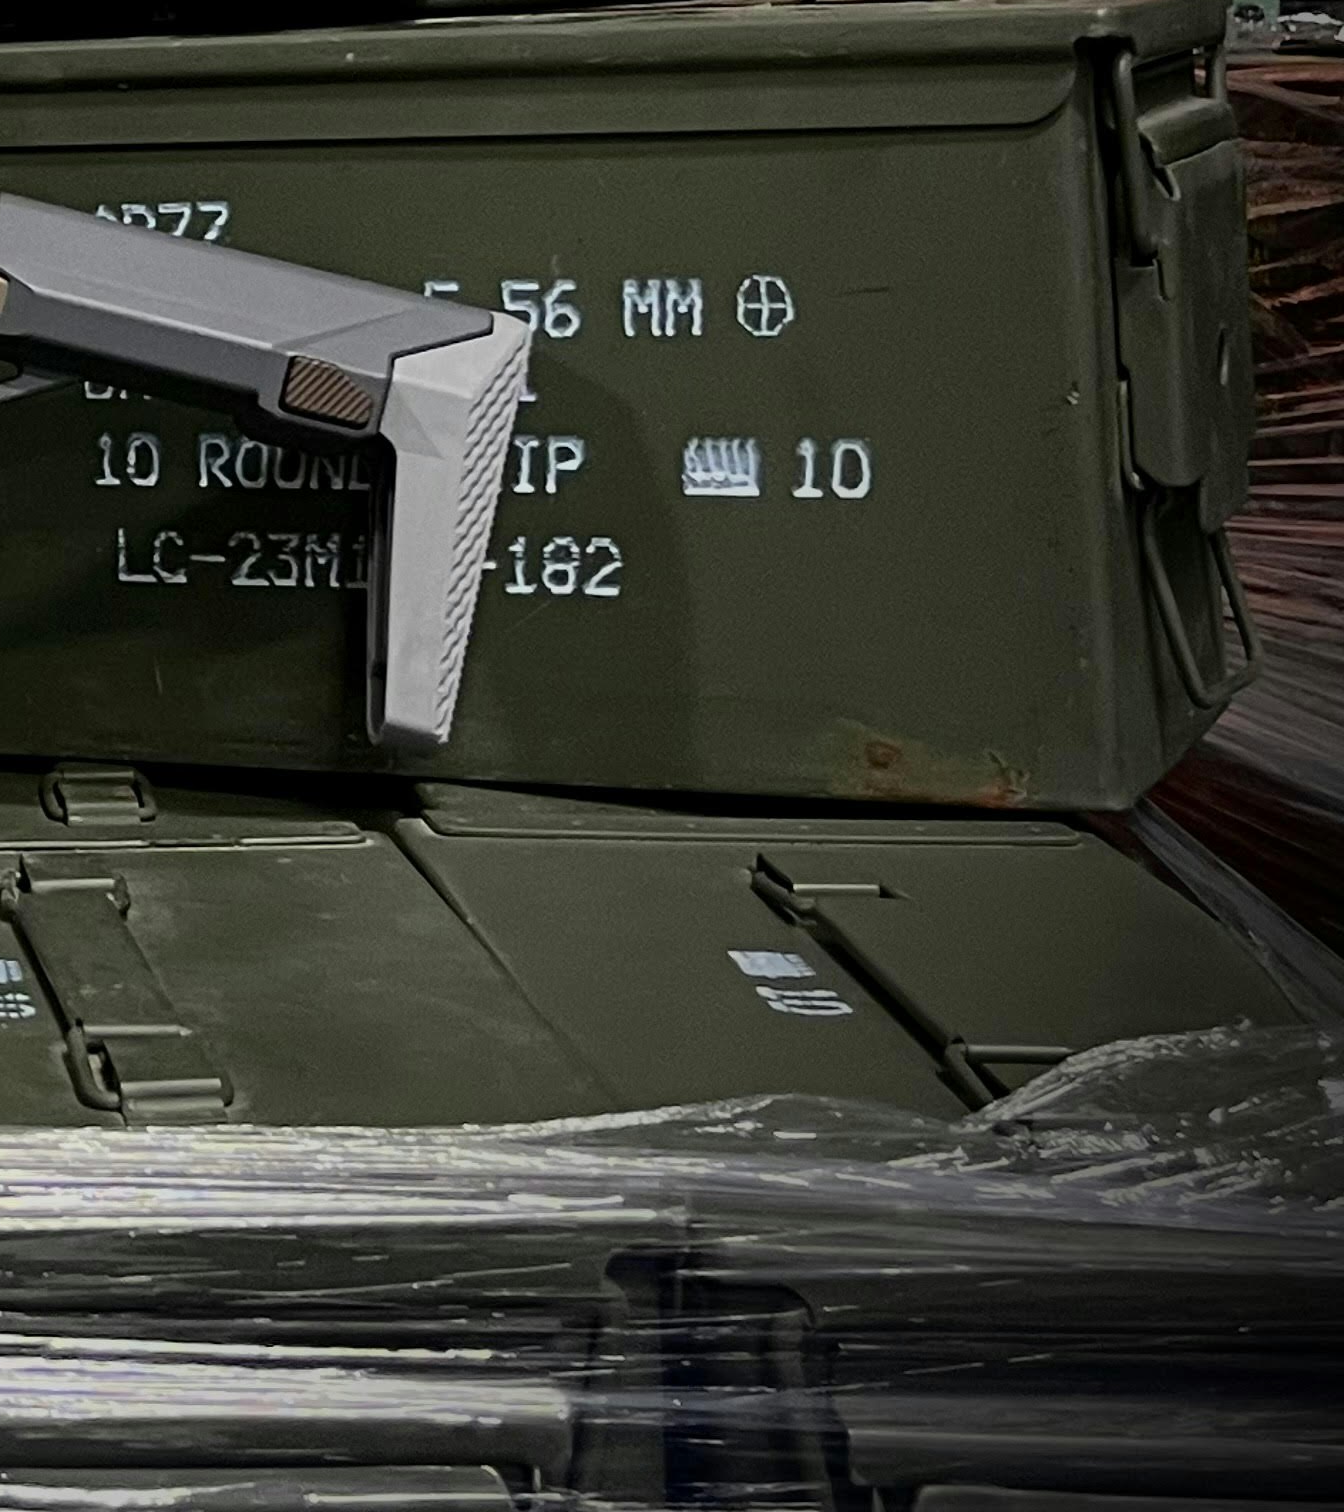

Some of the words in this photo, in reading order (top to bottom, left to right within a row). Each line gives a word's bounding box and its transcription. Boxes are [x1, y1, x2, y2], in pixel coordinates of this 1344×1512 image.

[622, 279, 703, 337] MM
[95, 434, 160, 487] 10
[792, 438, 871, 499] 10
